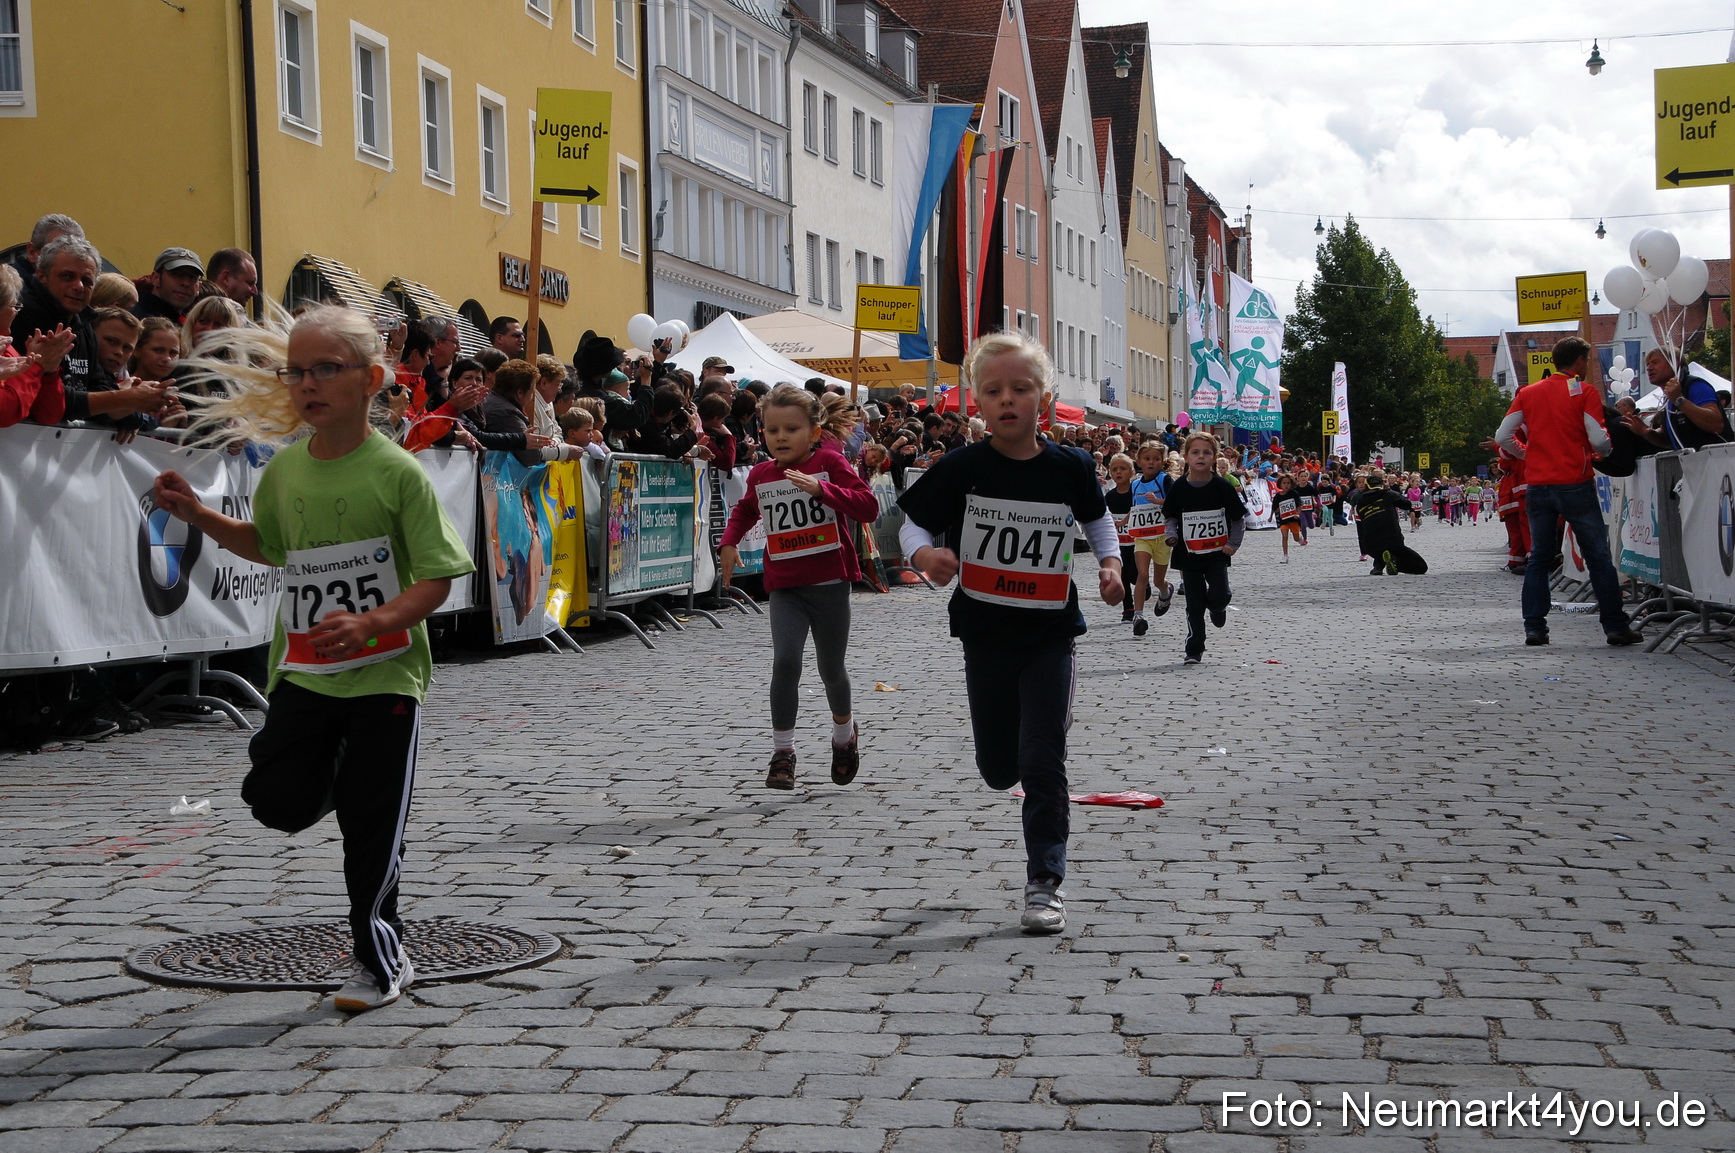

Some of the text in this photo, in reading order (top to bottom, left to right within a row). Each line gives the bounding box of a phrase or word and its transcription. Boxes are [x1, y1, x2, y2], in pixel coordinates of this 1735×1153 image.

[1658, 96, 1735, 121] Jugend-
[539, 119, 608, 141] Jugend-
[1680, 120, 1717, 140] lauf
[557, 142, 590, 160] lauf
[860, 297, 915, 310] Schnupper-
[1521, 288, 1582, 300] Schnupper-
[1542, 301, 1562, 311] lauf
[878, 311, 897, 321] lauf
[1532, 354, 1555, 365] Bloc
[1326, 418, 1335, 430] B
[1420, 457, 1427, 466] C
[763, 497, 826, 532] 7208
[967, 504, 1062, 526] PARTL Neumarkt
[1131, 511, 1162, 528] 7042
[1187, 520, 1225, 539] 7255
[778, 532, 818, 551] Sophia
[975, 523, 1066, 568] 7047
[302, 554, 370, 576] Neumarkt
[211, 565, 270, 606] Weniger
[994, 575, 1037, 596] Anne
[287, 573, 388, 631] 7235
